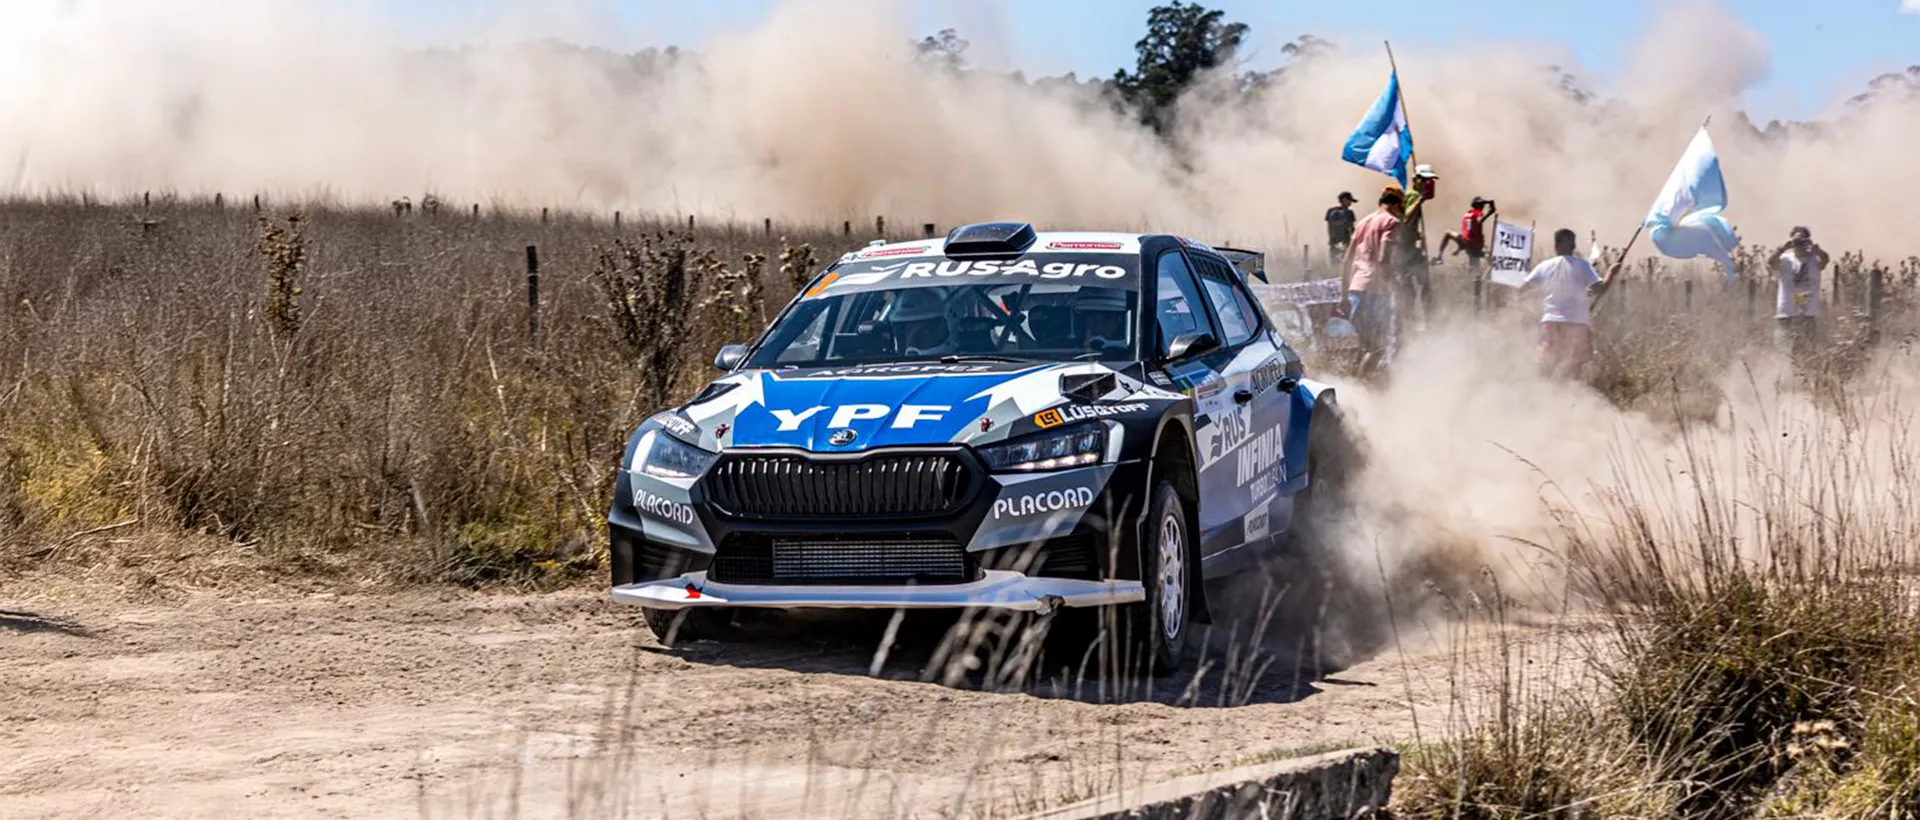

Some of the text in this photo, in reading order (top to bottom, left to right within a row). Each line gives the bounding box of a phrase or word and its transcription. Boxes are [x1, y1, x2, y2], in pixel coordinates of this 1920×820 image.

[771, 404, 952, 431] YPF
[1222, 406, 1246, 451] RUS
[1236, 423, 1285, 487] INFINIA
[633, 489, 693, 525] PLACORD
[993, 486, 1093, 520] PLACORD
